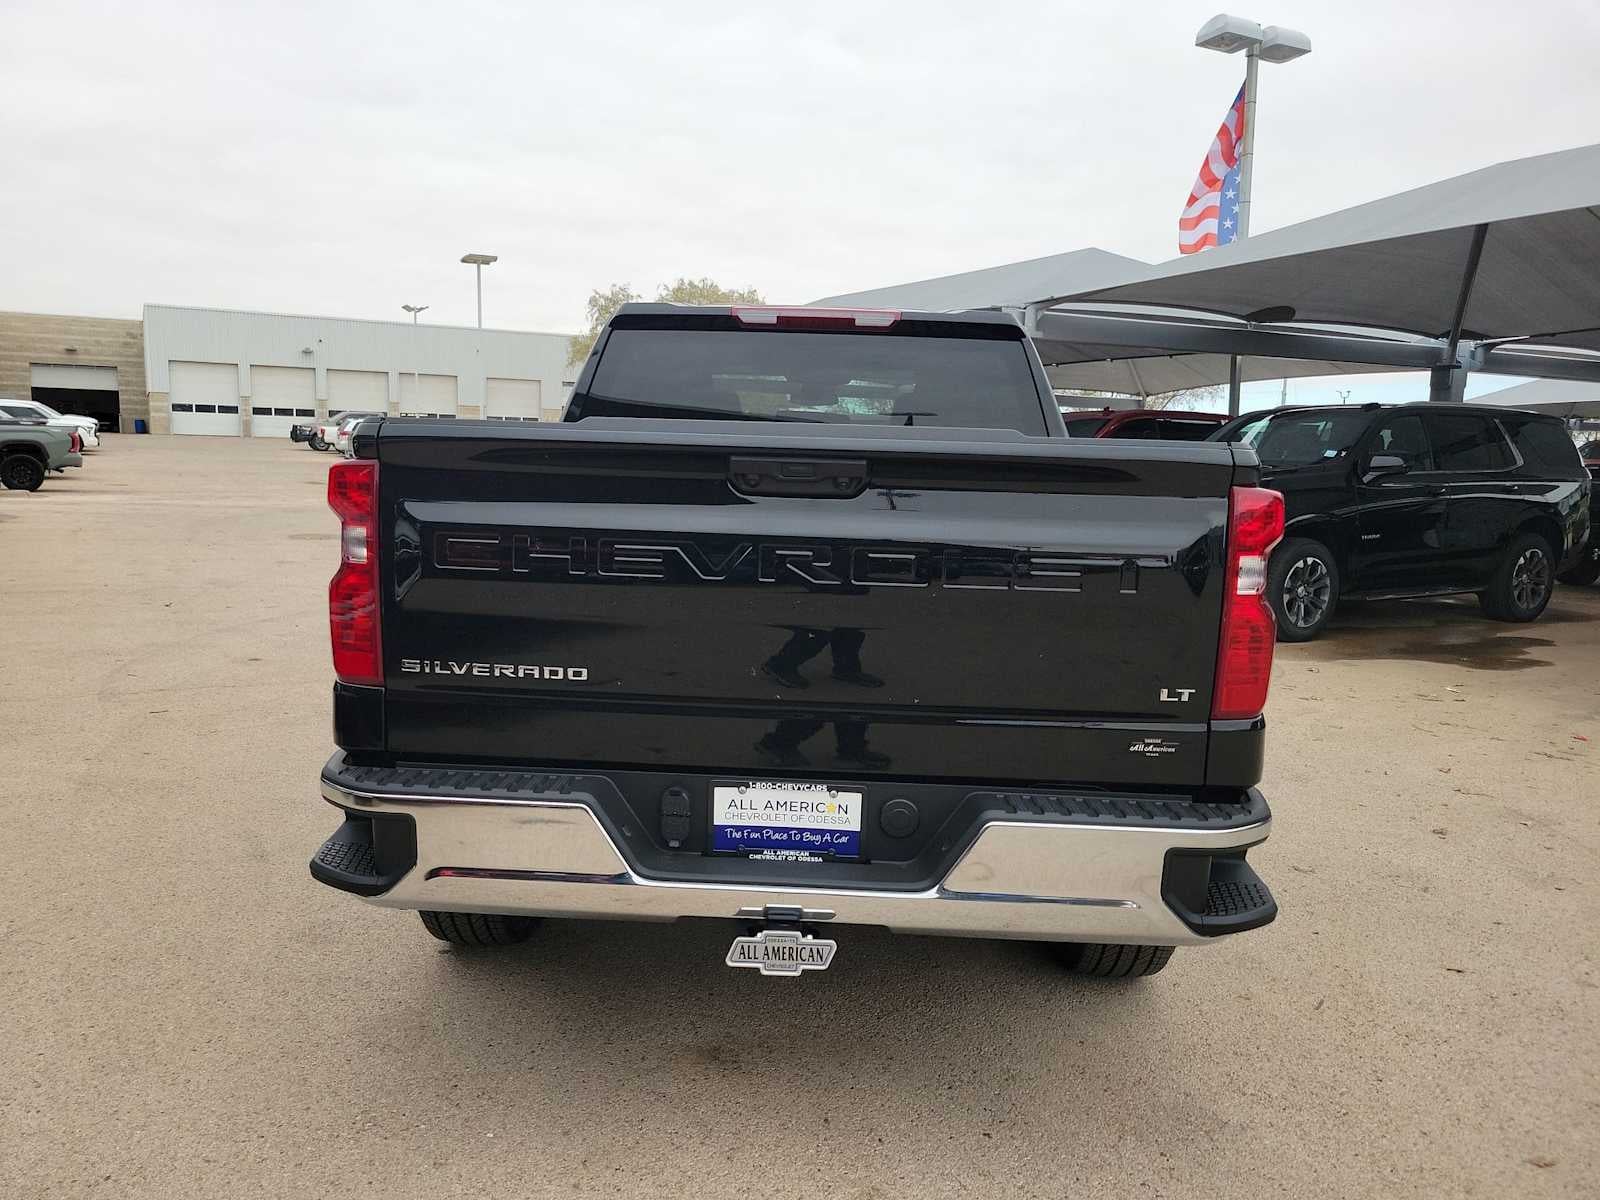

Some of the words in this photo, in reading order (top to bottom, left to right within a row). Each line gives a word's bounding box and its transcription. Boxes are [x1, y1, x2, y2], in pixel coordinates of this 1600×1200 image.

[433, 531, 1169, 594] CHEVROLET
[401, 658, 588, 681] SILVERADO
[1159, 688, 1196, 702] LT
[748, 782, 828, 792] 1-800-CHEVYCARS
[727, 799, 758, 811] ALL
[763, 800, 848, 815] AMERICN
[724, 812, 787, 822] CHEVROLET
[791, 814, 806, 822] OF
[807, 815, 851, 825] ODESSA
[725, 828, 742, 839] The
[743, 829, 761, 840] Fun
[762, 829, 788, 841] Place
[789, 830, 801, 841] To
[802, 831, 822, 845] Buy
[822, 833, 832, 843] A
[833, 833, 850, 844] Car
[748, 854, 786, 862] CHEVROLET
[738, 944, 759, 960] ALL
[762, 945, 824, 962] AMERICAN
